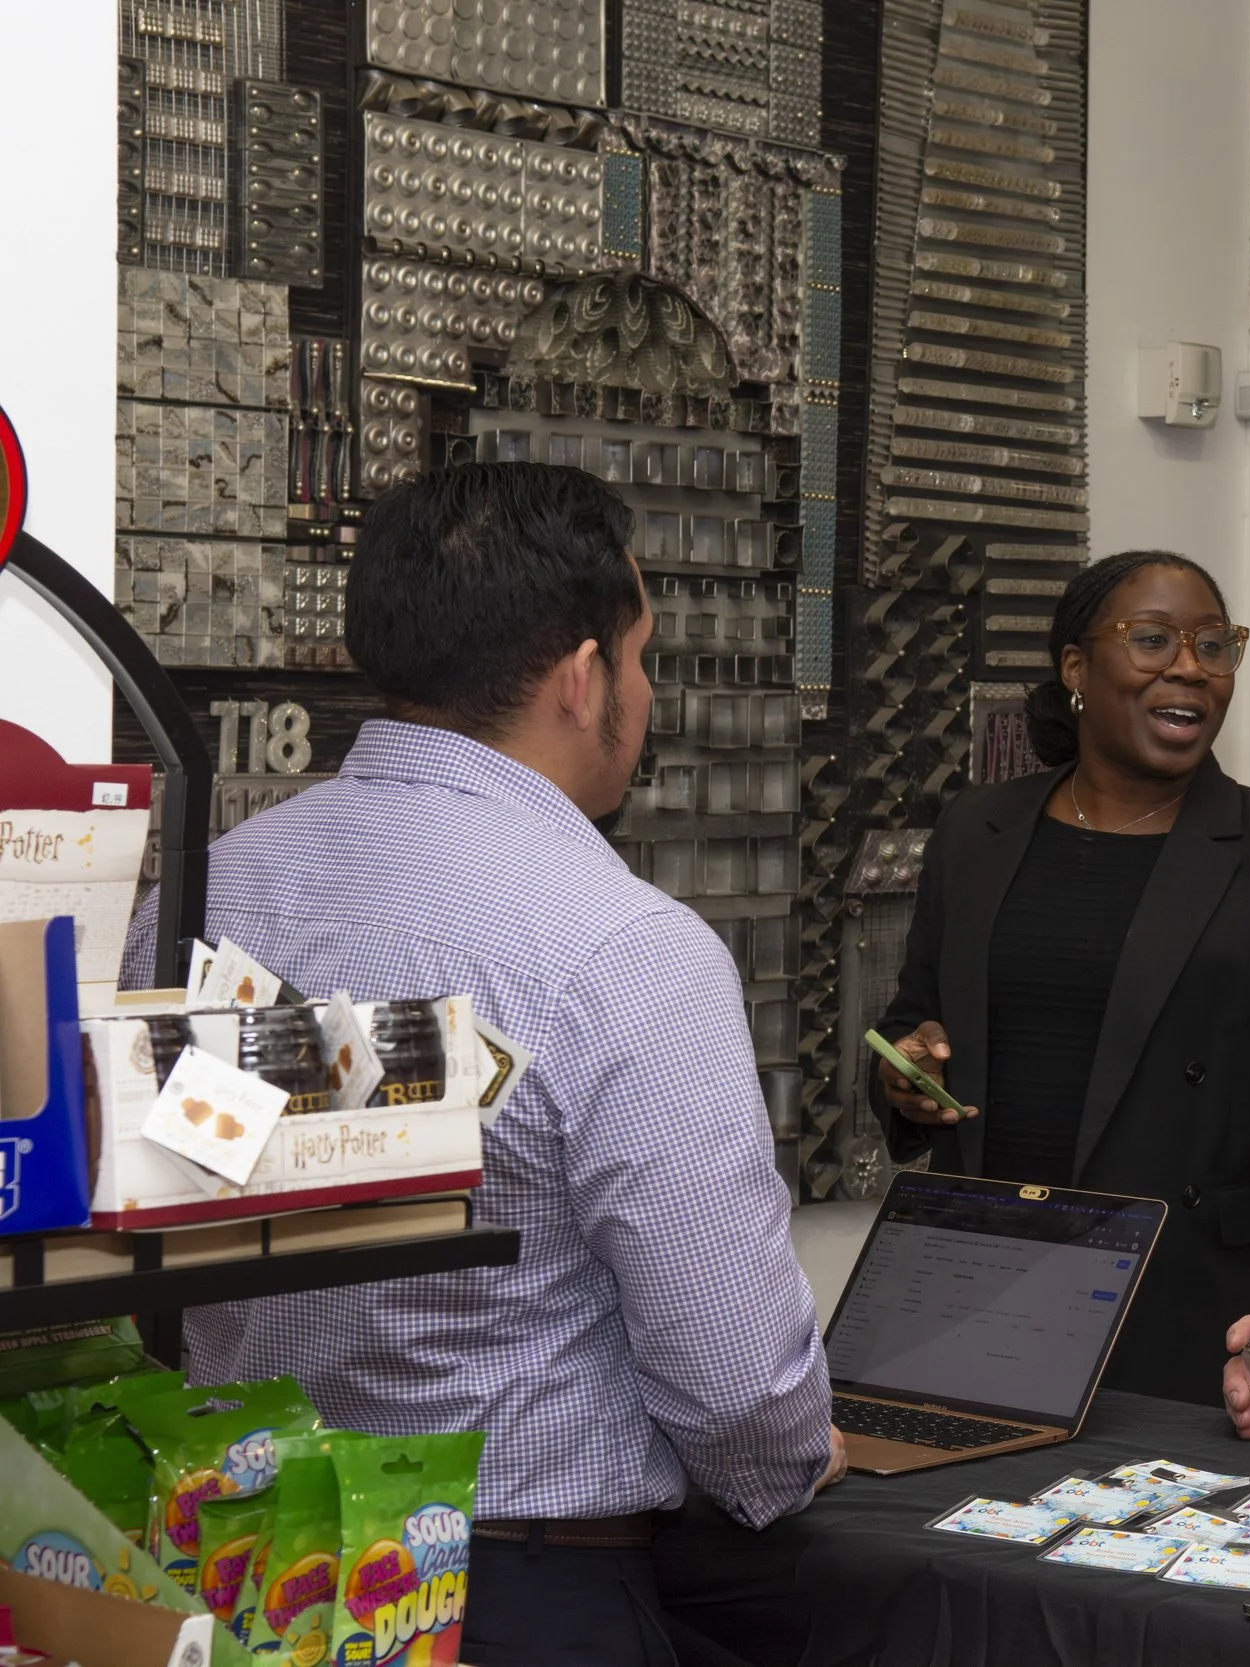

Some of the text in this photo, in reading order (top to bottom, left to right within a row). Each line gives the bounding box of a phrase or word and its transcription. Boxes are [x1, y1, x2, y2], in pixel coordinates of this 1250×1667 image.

[210, 701, 312, 774] 118
[0, 820, 64, 865] Potter
[292, 1124, 388, 1169] Harry Potter
[405, 1510, 468, 1547] SOUR
[25, 1543, 91, 1589] SOUR
[359, 1550, 401, 1588] FACE
[374, 1570, 469, 1660] DOUGH
